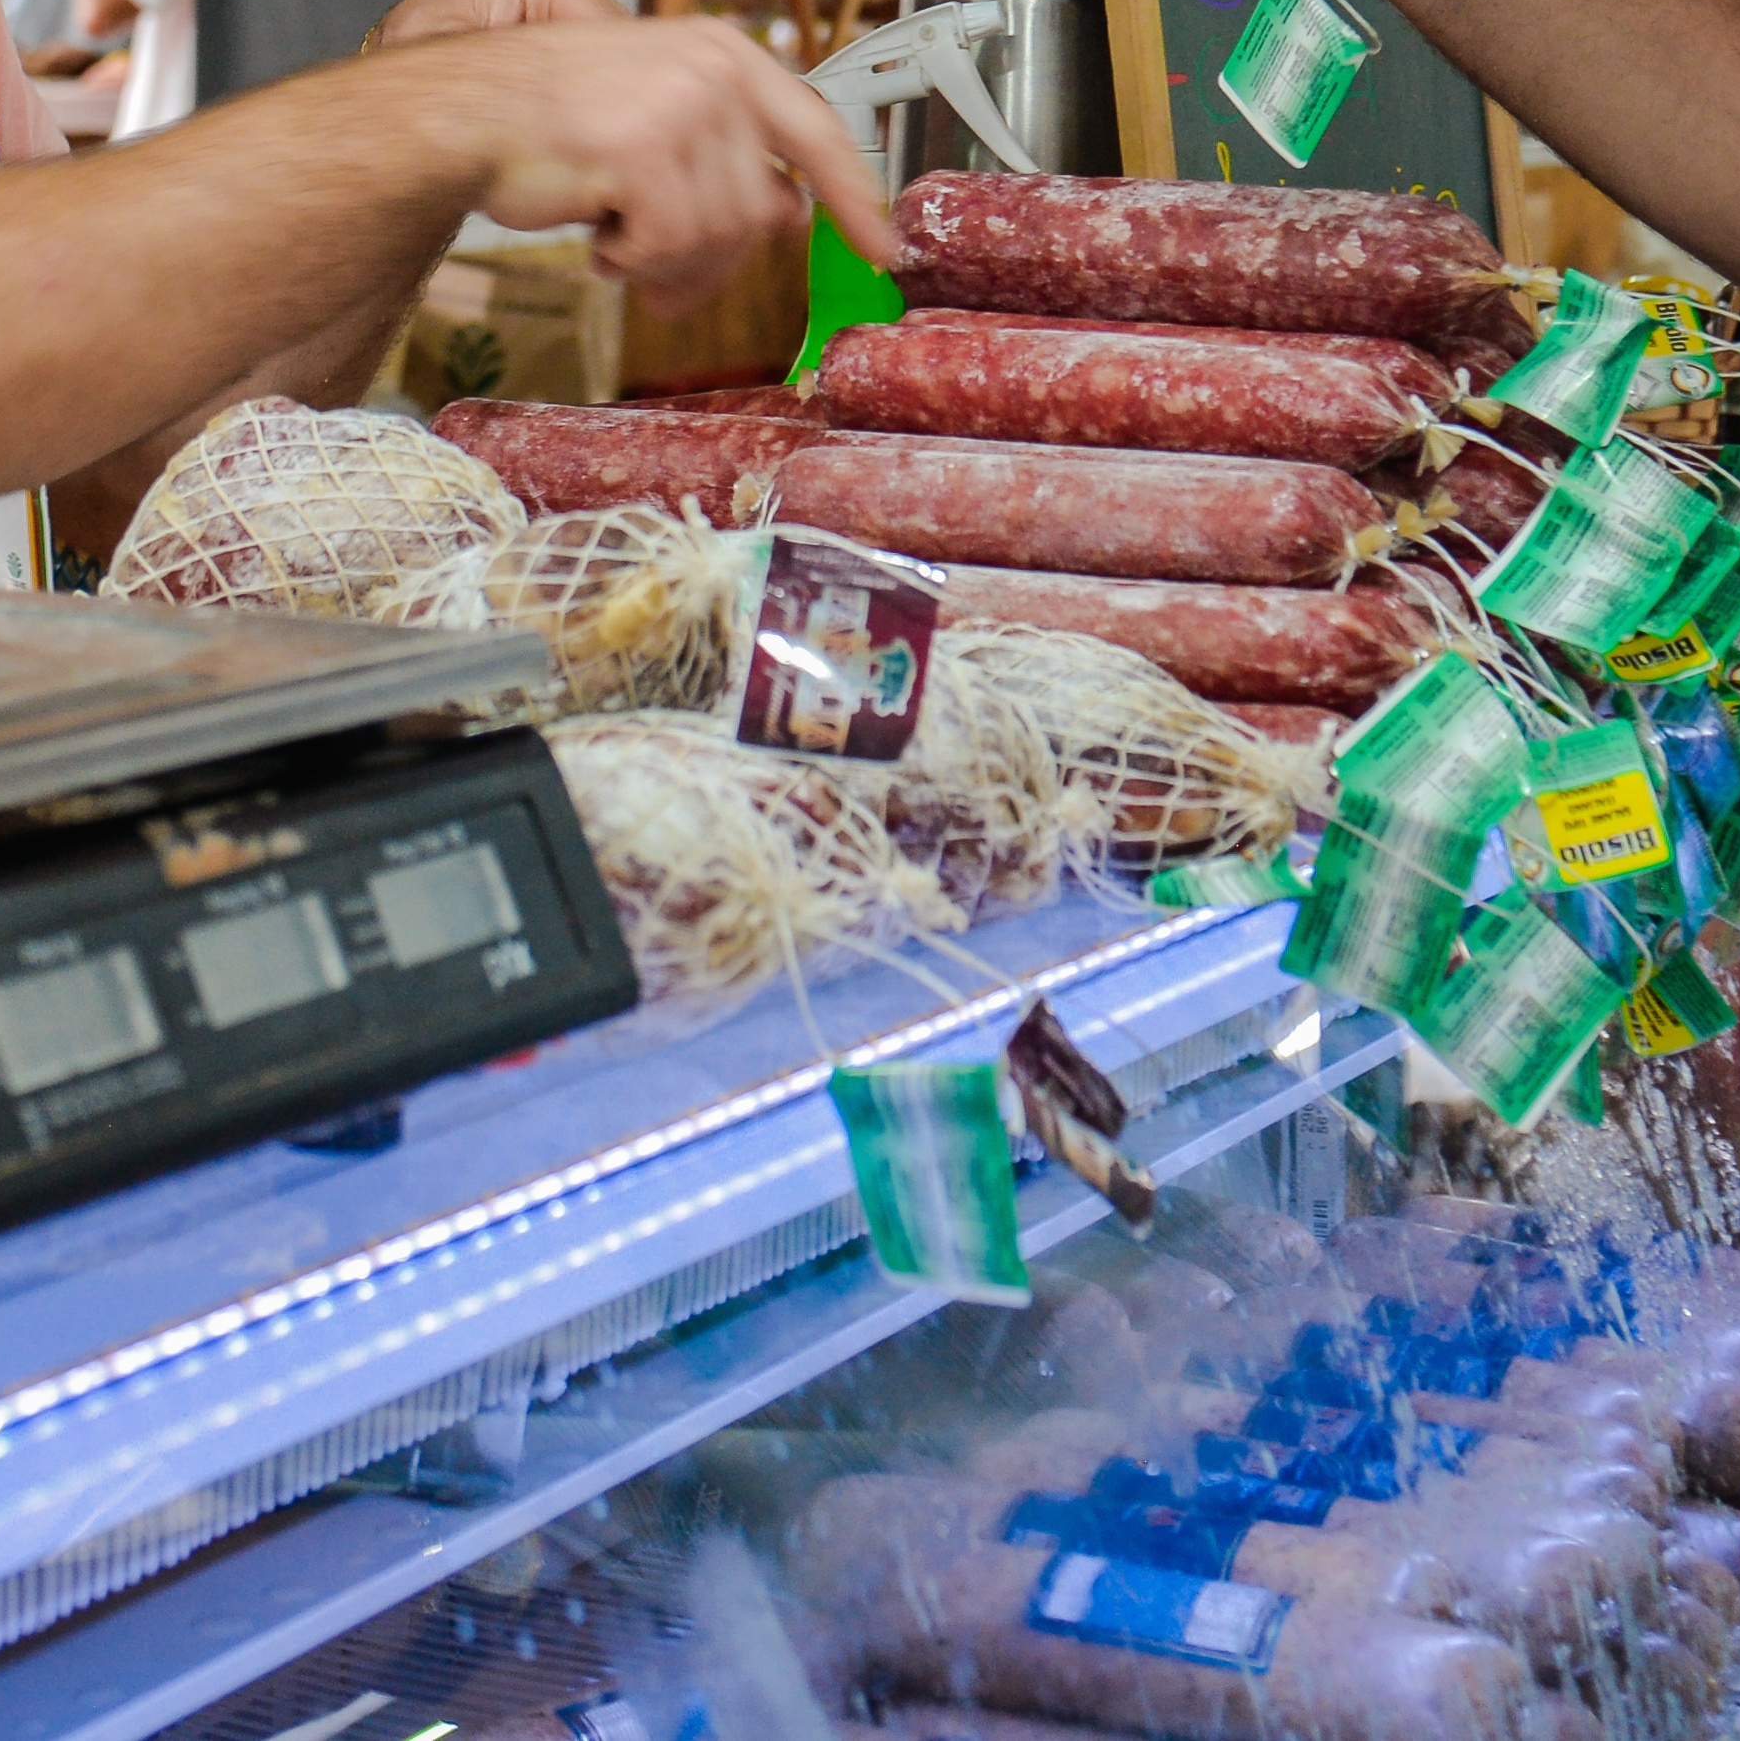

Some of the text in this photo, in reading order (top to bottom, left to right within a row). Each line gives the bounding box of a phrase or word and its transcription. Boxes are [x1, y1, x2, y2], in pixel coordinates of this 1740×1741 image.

[1654, 302, 1689, 353] Biolo
[1610, 636, 1698, 670] Bisolo
[1559, 826, 1657, 866] Bisolo
